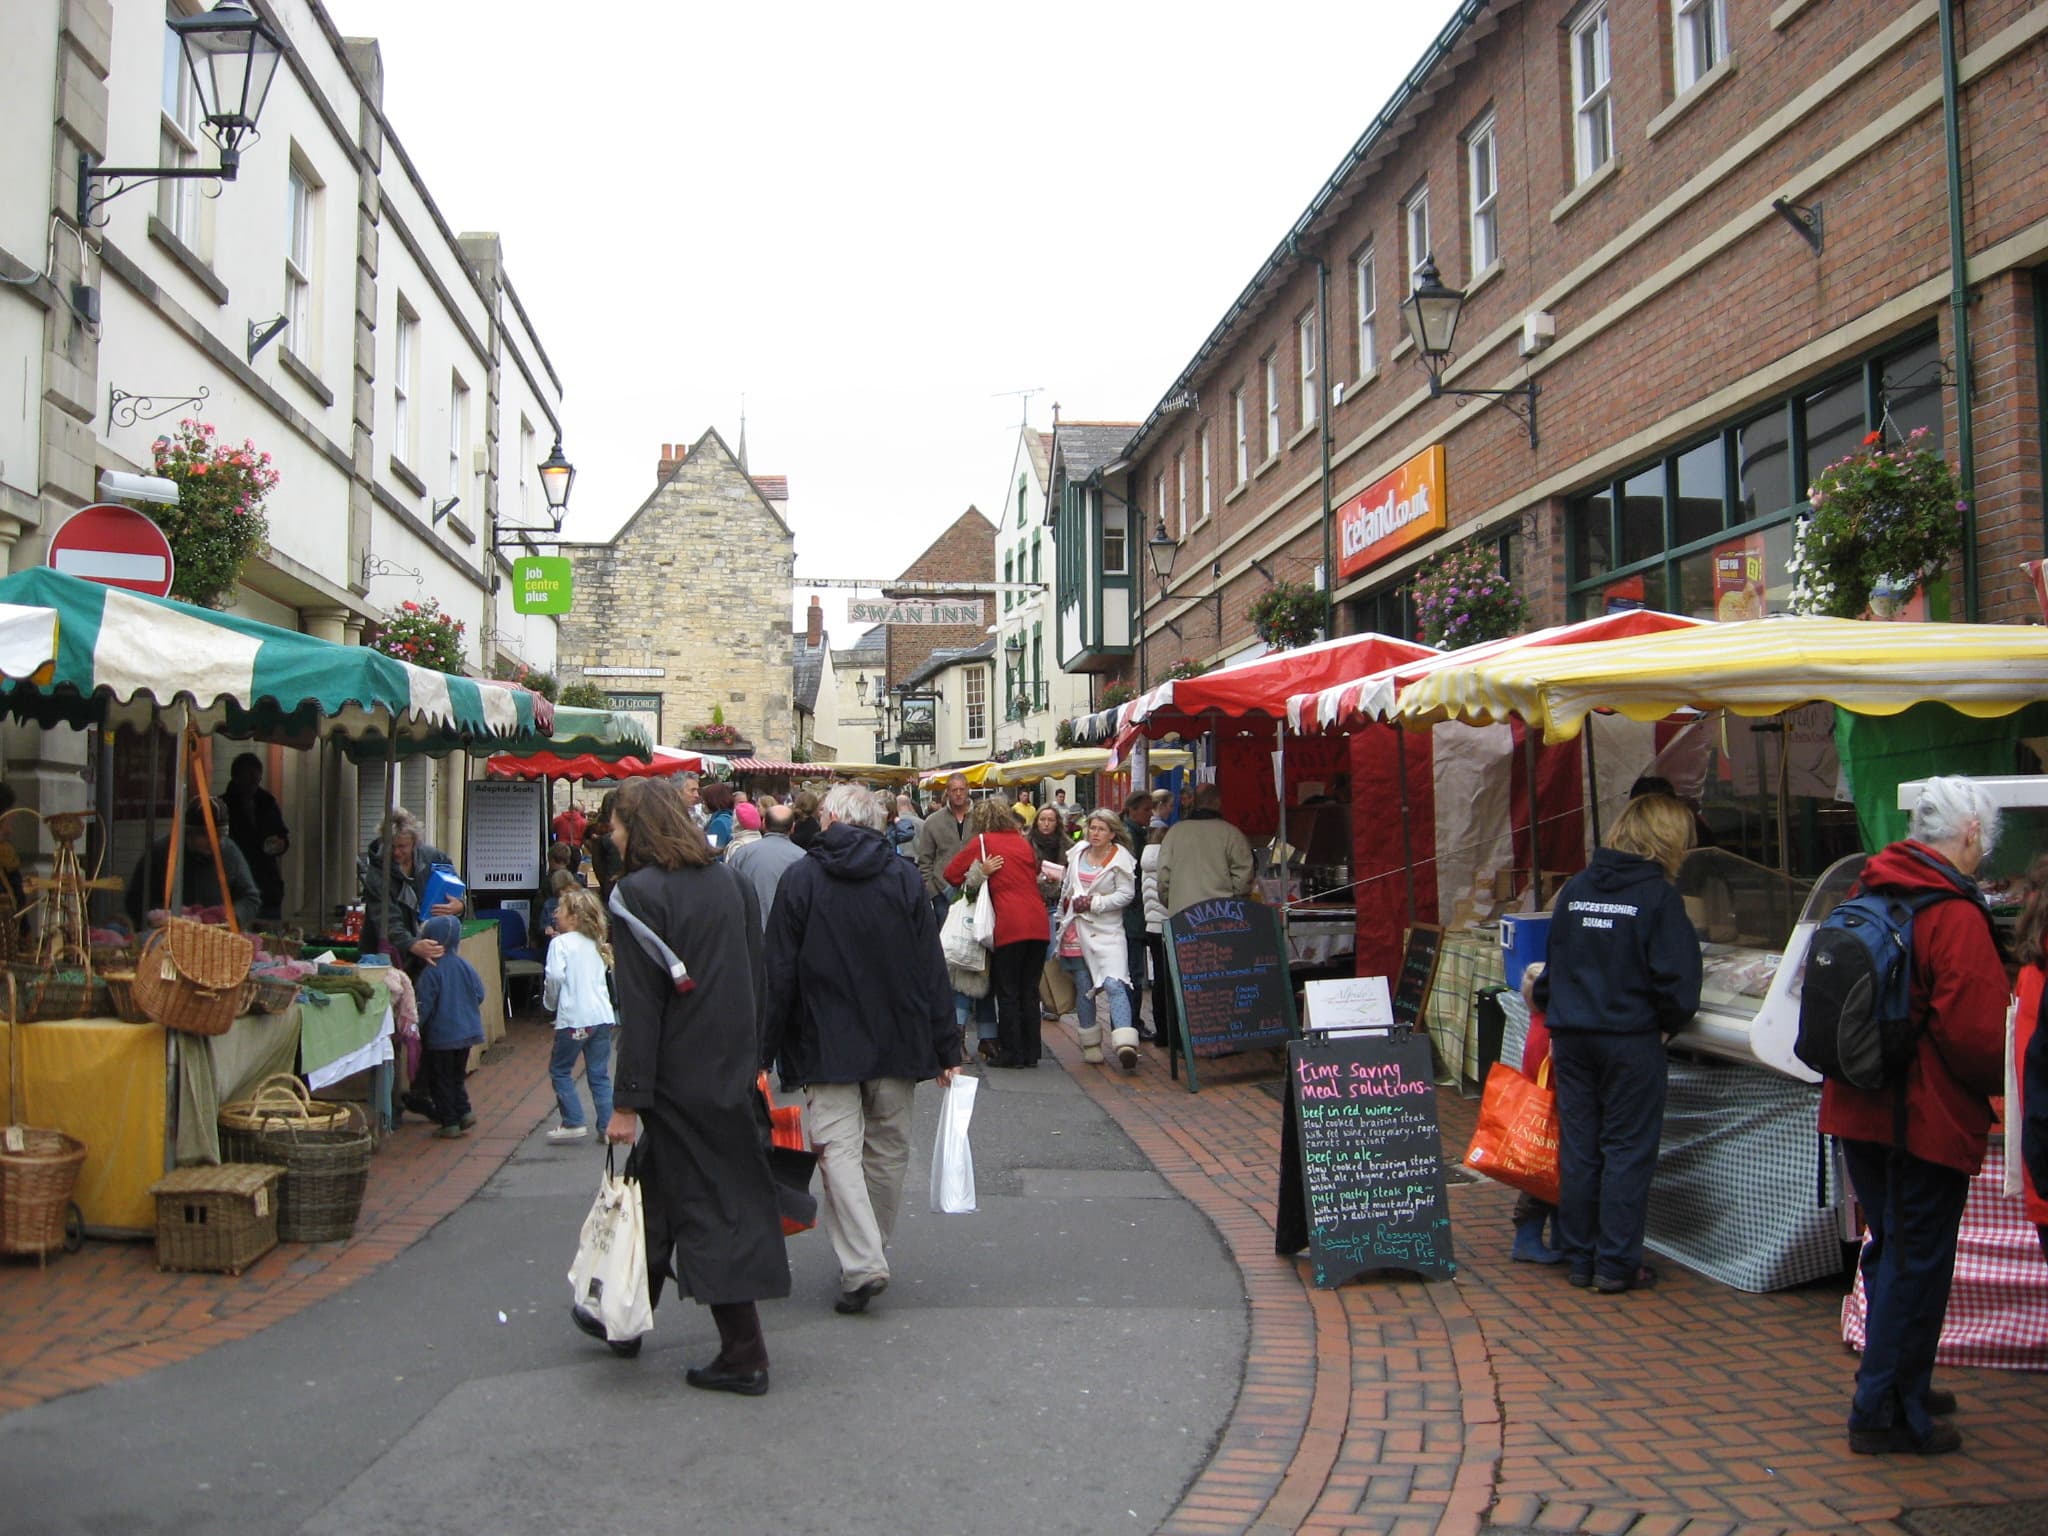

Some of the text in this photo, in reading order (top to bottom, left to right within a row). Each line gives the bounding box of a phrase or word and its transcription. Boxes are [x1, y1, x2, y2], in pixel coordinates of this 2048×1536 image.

[525, 567, 543, 581] job
[525, 579, 560, 591] centre
[525, 590, 548, 605] plus
[852, 603, 978, 623] SWAN INN
[608, 697, 658, 710] OLD GEORGE
[475, 784, 535, 794] Adapted Seats
[1568, 901, 1639, 917] GOUCESTERSHIRE
[1582, 917, 1614, 929] SQUASH
[1297, 1058, 1401, 1089] time saving
[1301, 1079, 1342, 1100] meal
[1302, 1104, 1325, 1122] beef
[1328, 1105, 1340, 1116] in
[1343, 1104, 1361, 1116] red
[1303, 1111, 1426, 1130] slow cooked braising steak
[1305, 1130, 1324, 1139] with
[1327, 1129, 1339, 1138] red
[1305, 1139, 1340, 1149] carrots
[1306, 1149, 1332, 1167] beef
[1336, 1151, 1348, 1162] in
[1307, 1154, 1437, 1174] slow cooked braising steak
[1309, 1174, 1330, 1184] with
[1392, 1167, 1429, 1179] carrots
[1311, 1193, 1335, 1208] puff
[1339, 1188, 1369, 1206] pastry
[1373, 1186, 1402, 1198] steak
[1313, 1205, 1332, 1216] with
[1340, 1202, 1358, 1212] hint
[1416, 1194, 1436, 1210] puff
[1313, 1213, 1340, 1232] pastry
[1351, 1210, 1388, 1221] delicious
[1388, 1208, 1415, 1226] gravy
[1376, 1223, 1432, 1246] Rosemary
[1374, 1242, 1409, 1260] Pastry
